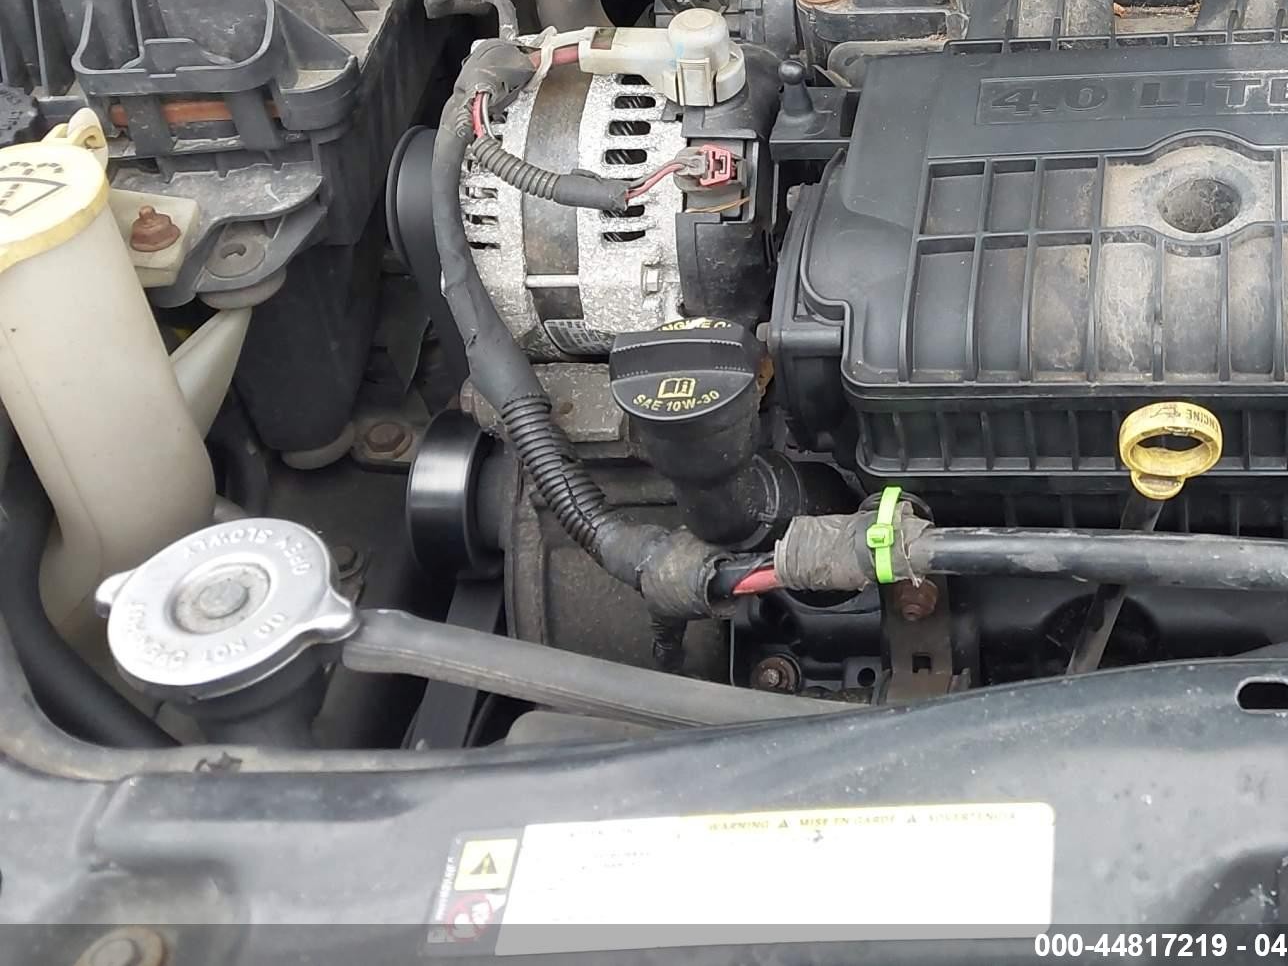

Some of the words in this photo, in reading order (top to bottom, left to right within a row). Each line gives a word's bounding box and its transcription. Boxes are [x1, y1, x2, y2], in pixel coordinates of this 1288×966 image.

[991, 86, 1108, 113] 4.0
[632, 394, 664, 411] SAE
[666, 390, 720, 412] 10W-30
[1186, 409, 1220, 433] ENGINE
